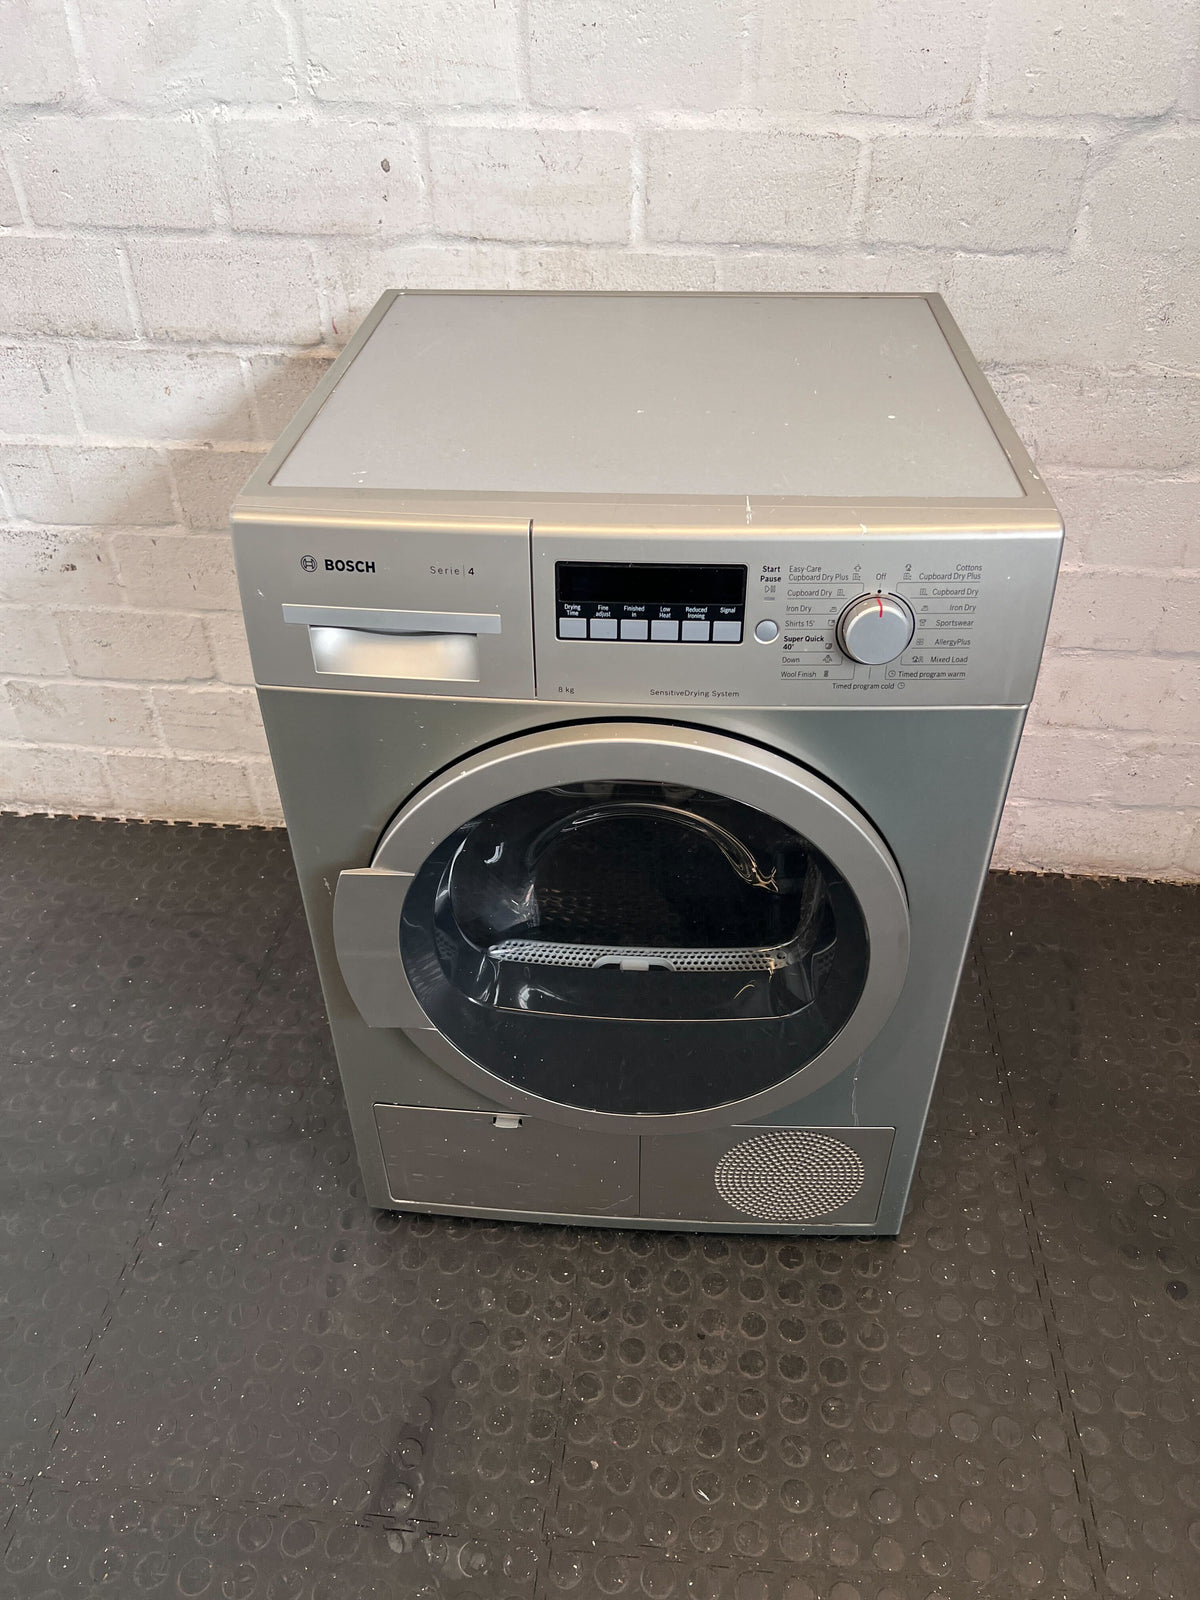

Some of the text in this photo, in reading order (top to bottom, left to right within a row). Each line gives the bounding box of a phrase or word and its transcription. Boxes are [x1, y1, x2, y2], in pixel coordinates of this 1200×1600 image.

[324, 559, 376, 574] BOSCH
[762, 565, 781, 573] Start
[789, 565, 822, 575] Easy Care
[955, 564, 983, 572] Cottons
[760, 575, 782, 583] Pause
[788, 573, 849, 583] Cupboard Dry Plus
[875, 573, 887, 581] Off
[918, 572, 981, 582] Cupboard Dry Plus
[787, 588, 833, 599] Cupboard Dry
[932, 588, 979, 598] Cupboard Dry
[564, 603, 581, 611] Drying
[623, 604, 645, 612] Finished
[685, 606, 708, 614] Reduced
[719, 606, 736, 614] Signal
[786, 605, 812, 614] Iron Dry
[950, 603, 977, 613] Iron Dry
[595, 610, 612, 619] adjust
[687, 612, 706, 620] Ironing
[785, 619, 805, 628] Shirts
[935, 619, 974, 629] Sportswear
[783, 635, 825, 644] Super Quick
[934, 638, 971, 647] AllergyPlus
[781, 656, 801, 664] Down
[780, 670, 817, 679] Wool Finish
[898, 670, 918, 678] Timed
[919, 671, 946, 680] program
[558, 686, 575, 695] 8 kg
[832, 682, 895, 692] Timed program cold
[711, 690, 740, 699] System
